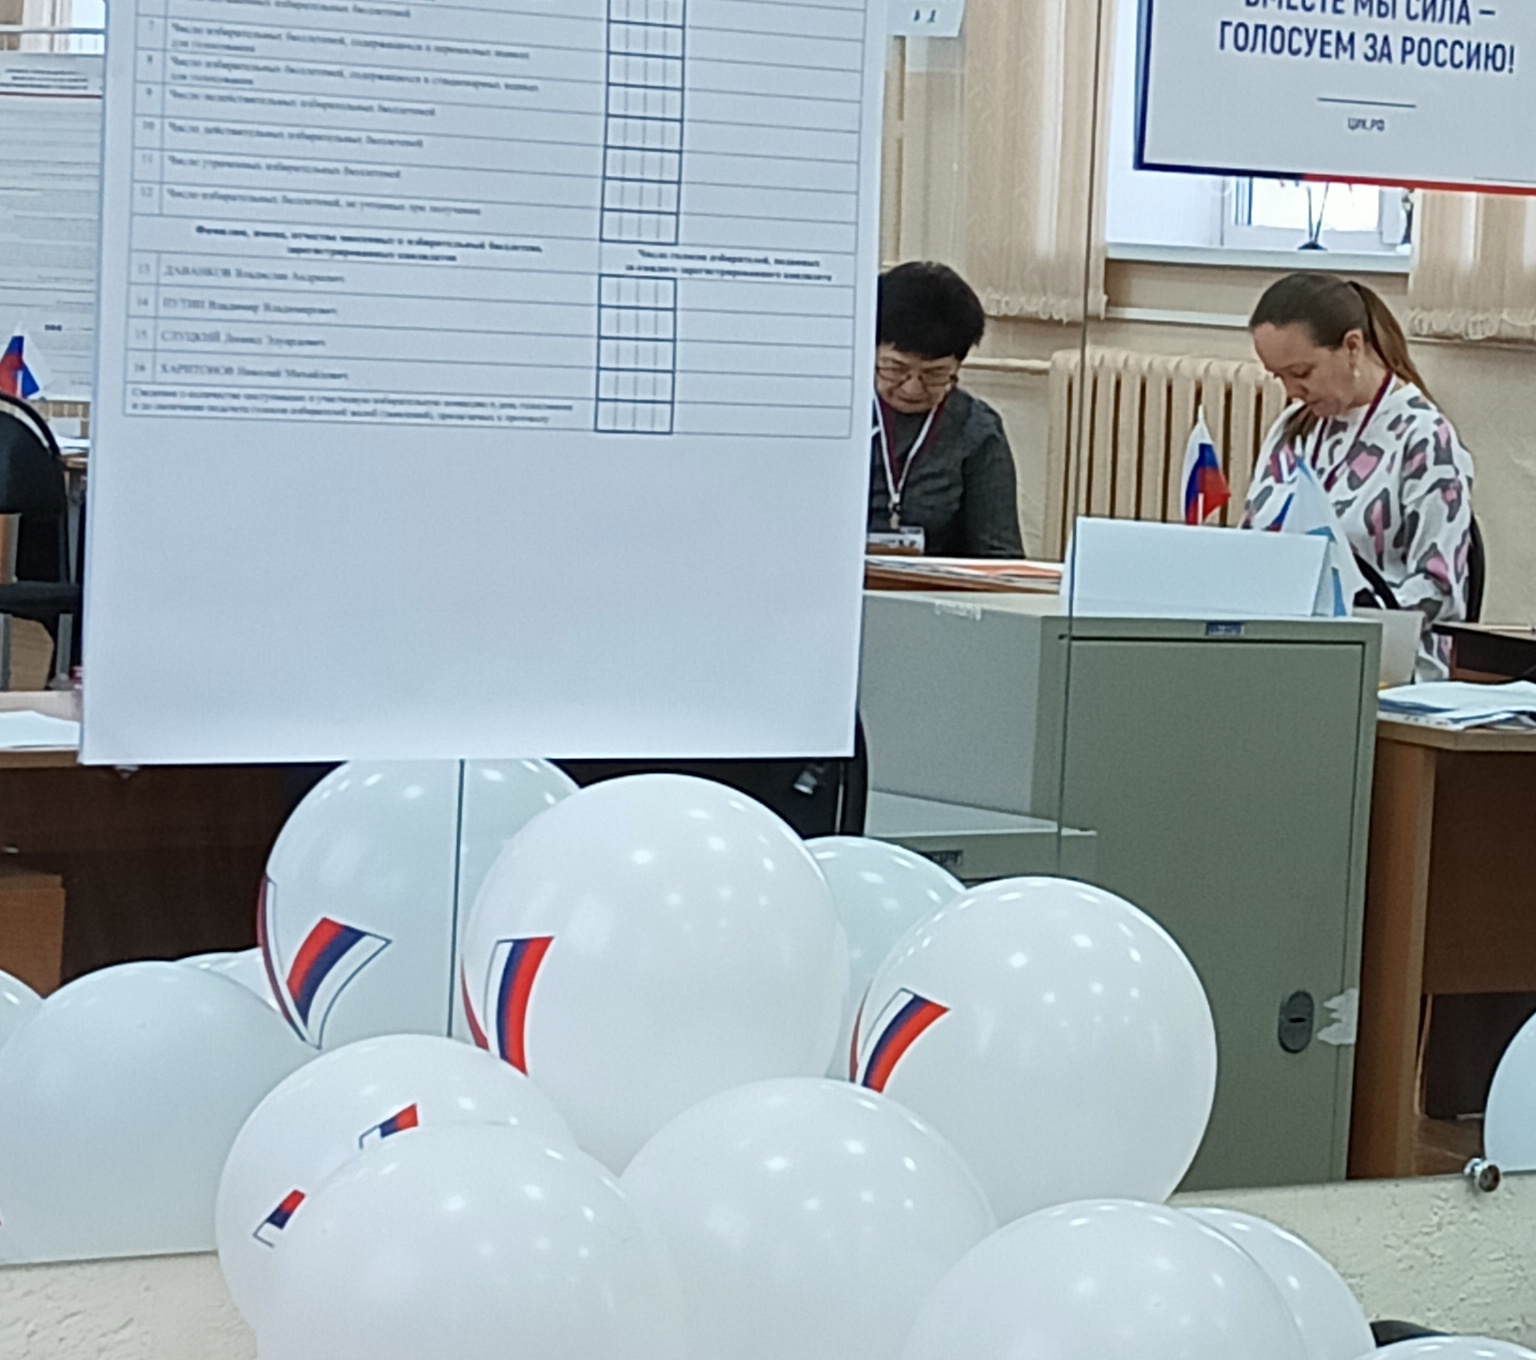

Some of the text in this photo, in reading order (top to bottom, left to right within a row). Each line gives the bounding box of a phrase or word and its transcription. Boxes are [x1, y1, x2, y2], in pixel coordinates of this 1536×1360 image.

[1219, 20, 1515, 73] ГОЛОСУЕМ ЗА РОССИЮ!
